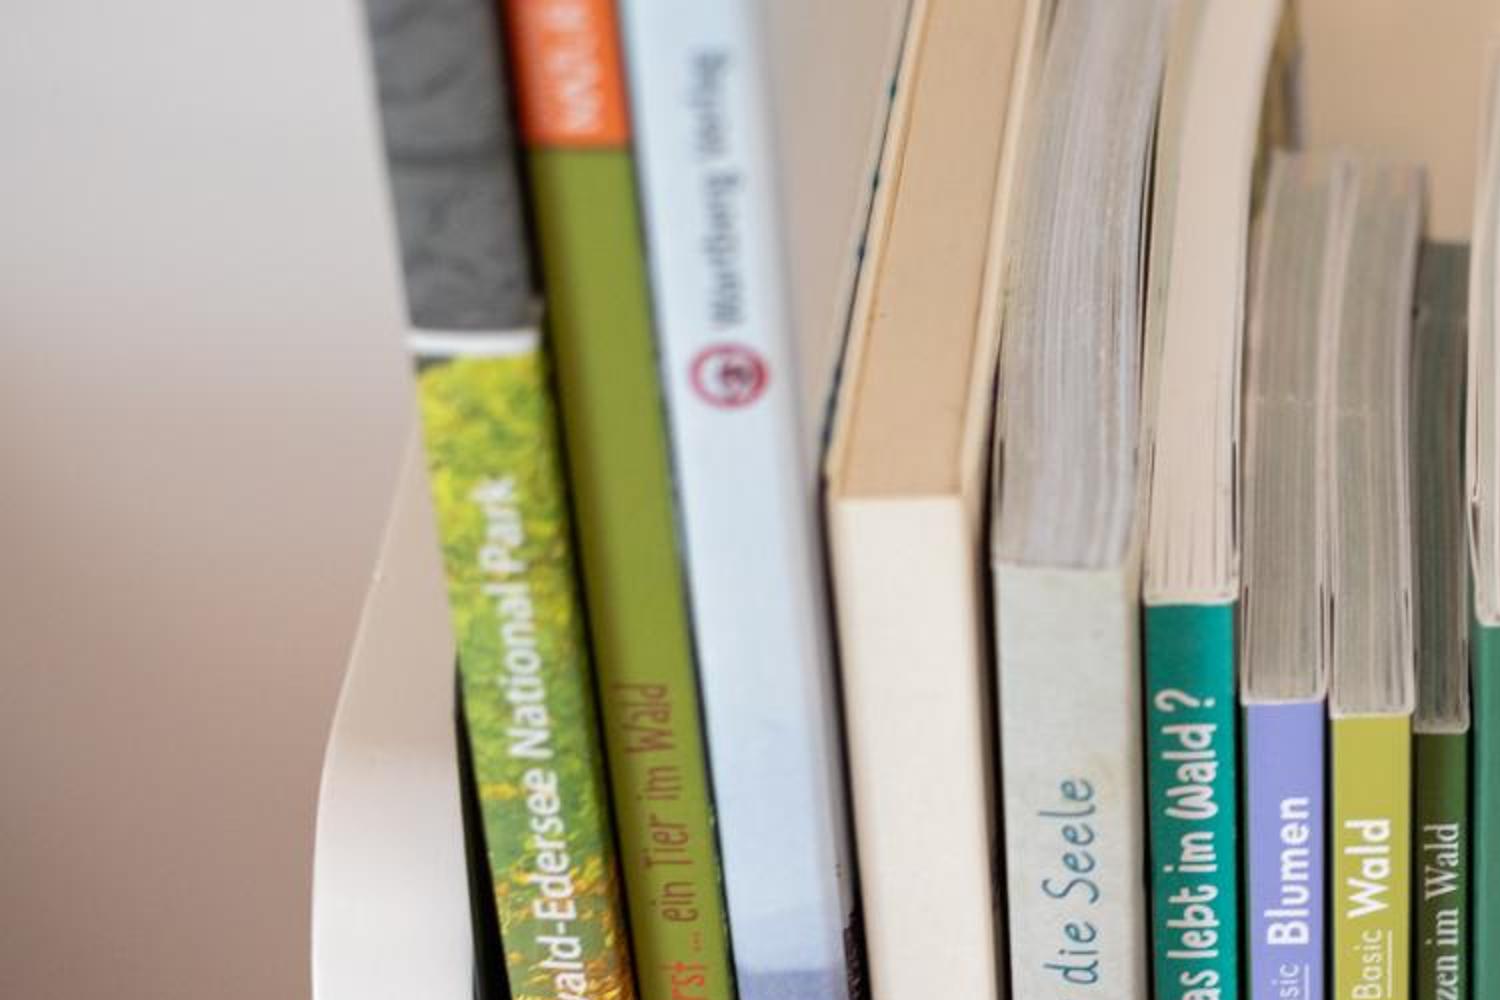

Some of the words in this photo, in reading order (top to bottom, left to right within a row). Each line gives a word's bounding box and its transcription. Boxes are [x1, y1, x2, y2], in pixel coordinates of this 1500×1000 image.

[469, 476, 527, 573] Park
[480, 583, 554, 760] National
[612, 683, 677, 755] Wald
[637, 766, 682, 800] im
[645, 815, 693, 870] Tier
[1037, 777, 1100, 904] Seele
[1164, 831, 1218, 873] im
[1264, 797, 1310, 945] Blumen
[1344, 818, 1391, 919] Wald
[1424, 823, 1459, 900] Wald
[656, 881, 698, 922] ein
[1167, 884, 1220, 959] lebt
[1426, 909, 1459, 946] im
[1044, 920, 1100, 985] die
[1352, 928, 1382, 1000] Basic
